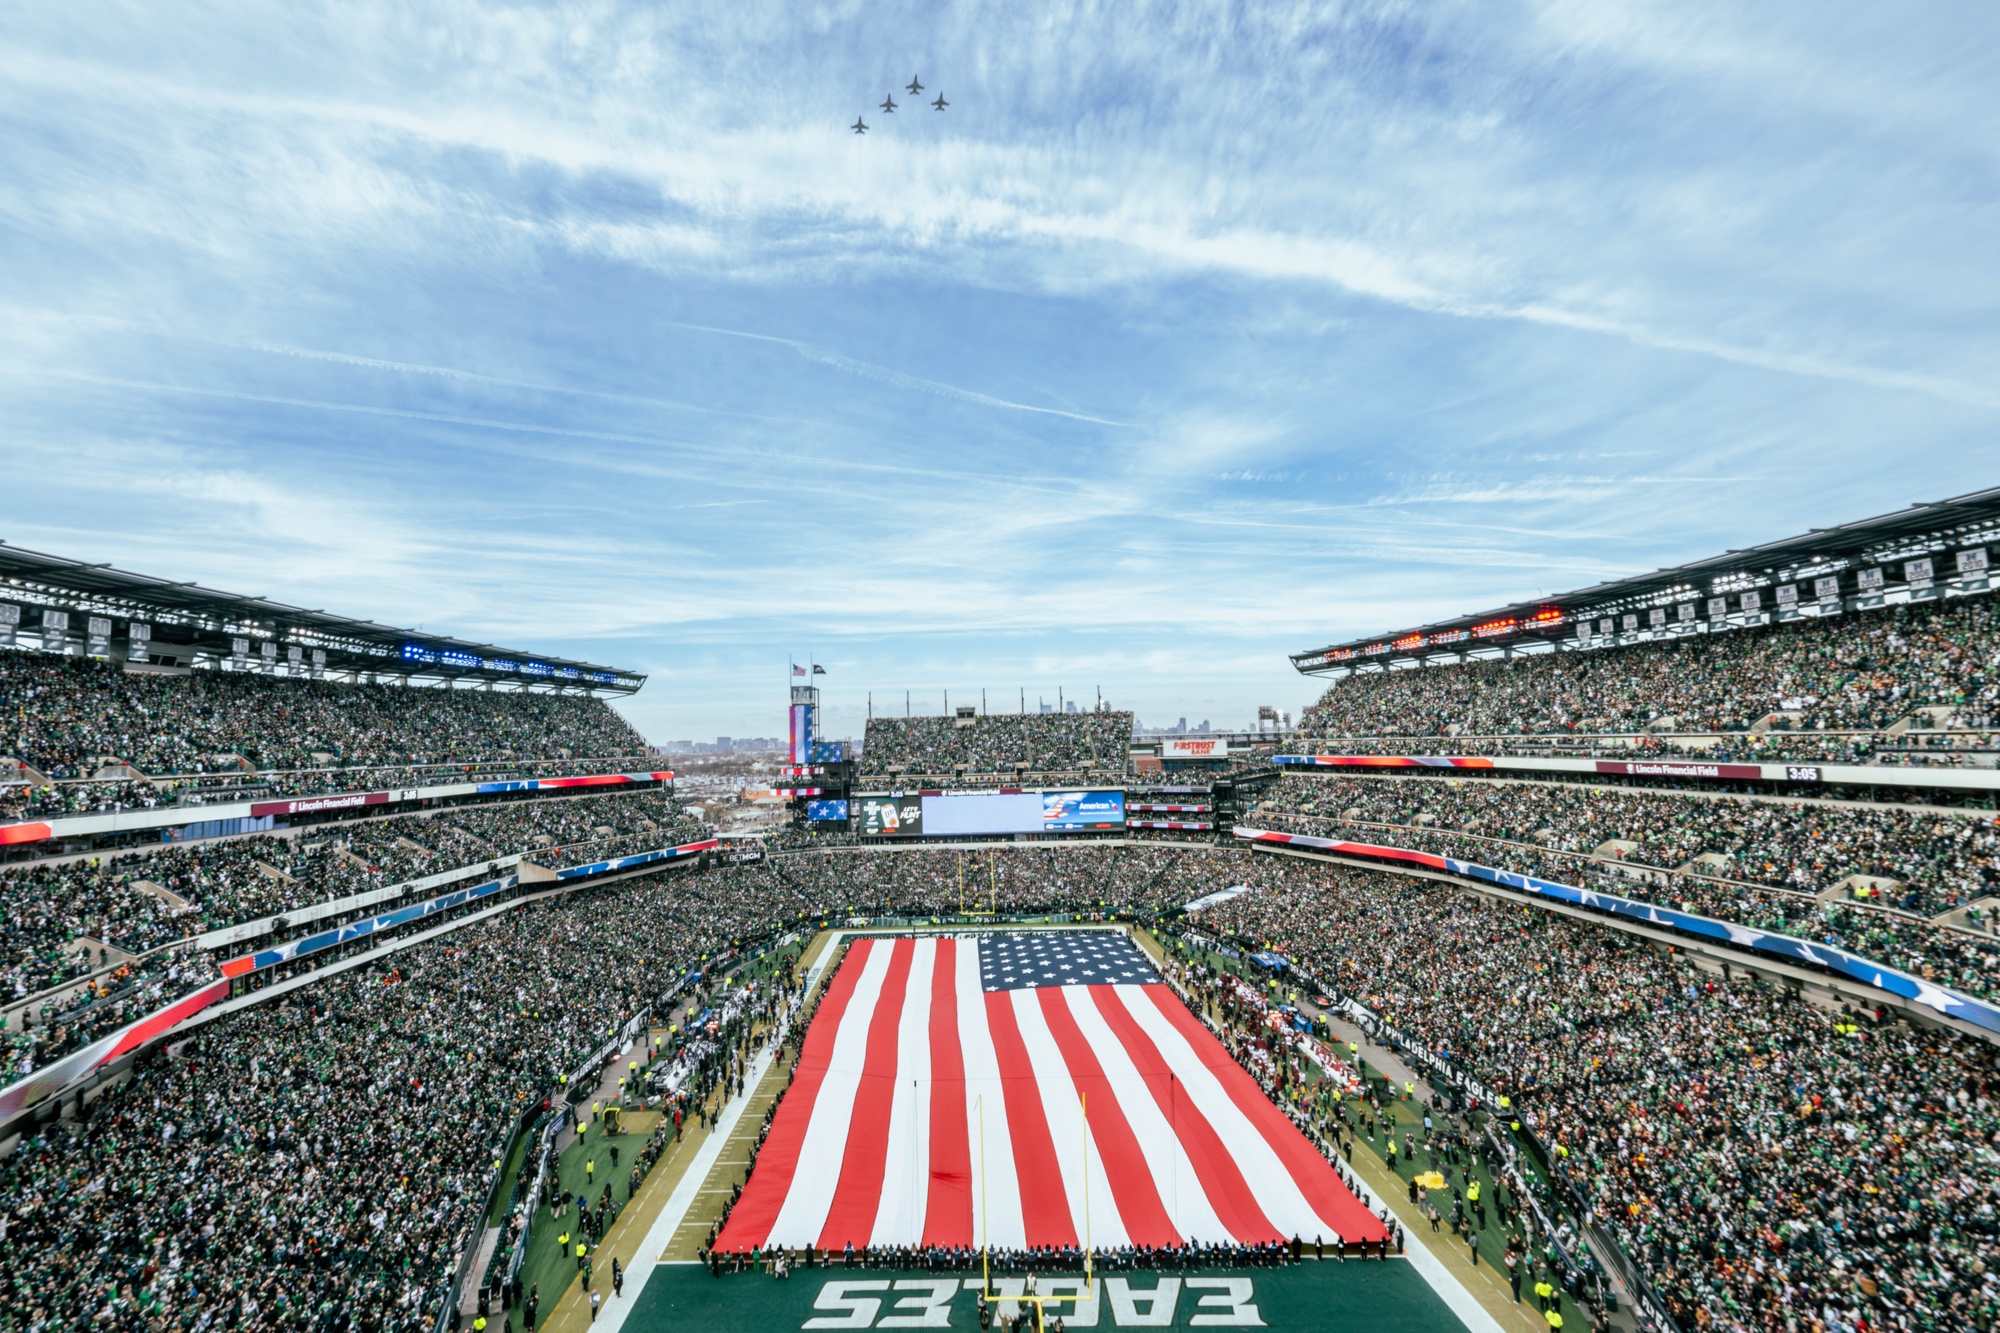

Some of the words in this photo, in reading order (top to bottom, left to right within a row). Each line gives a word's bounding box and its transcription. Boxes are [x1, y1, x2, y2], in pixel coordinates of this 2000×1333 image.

[1908, 568, 1930, 580] 2006
[1860, 577, 1881, 588] 2004
[130, 623, 150, 641] 70
[1635, 764, 1662, 774] Lincoln
[1662, 765, 1697, 775] Financial
[1697, 766, 1719, 776] Field
[1789, 767, 1817, 780] 3:05
[402, 790, 418, 800] 3:05
[890, 790, 904, 798] 3:05
[298, 801, 322, 811] Lincoln
[322, 798, 350, 810] Financial
[350, 796, 366, 806] Field
[1079, 802, 1110, 810] American
[899, 811, 922, 819] HUNT
[1385, 1025, 1453, 1079] PHILADELPHIA
[1456, 1070, 1502, 1110] EAGLES
[800, 1277, 1269, 1328] EAGLES
[1641, 1294, 1655, 1319] FLY
